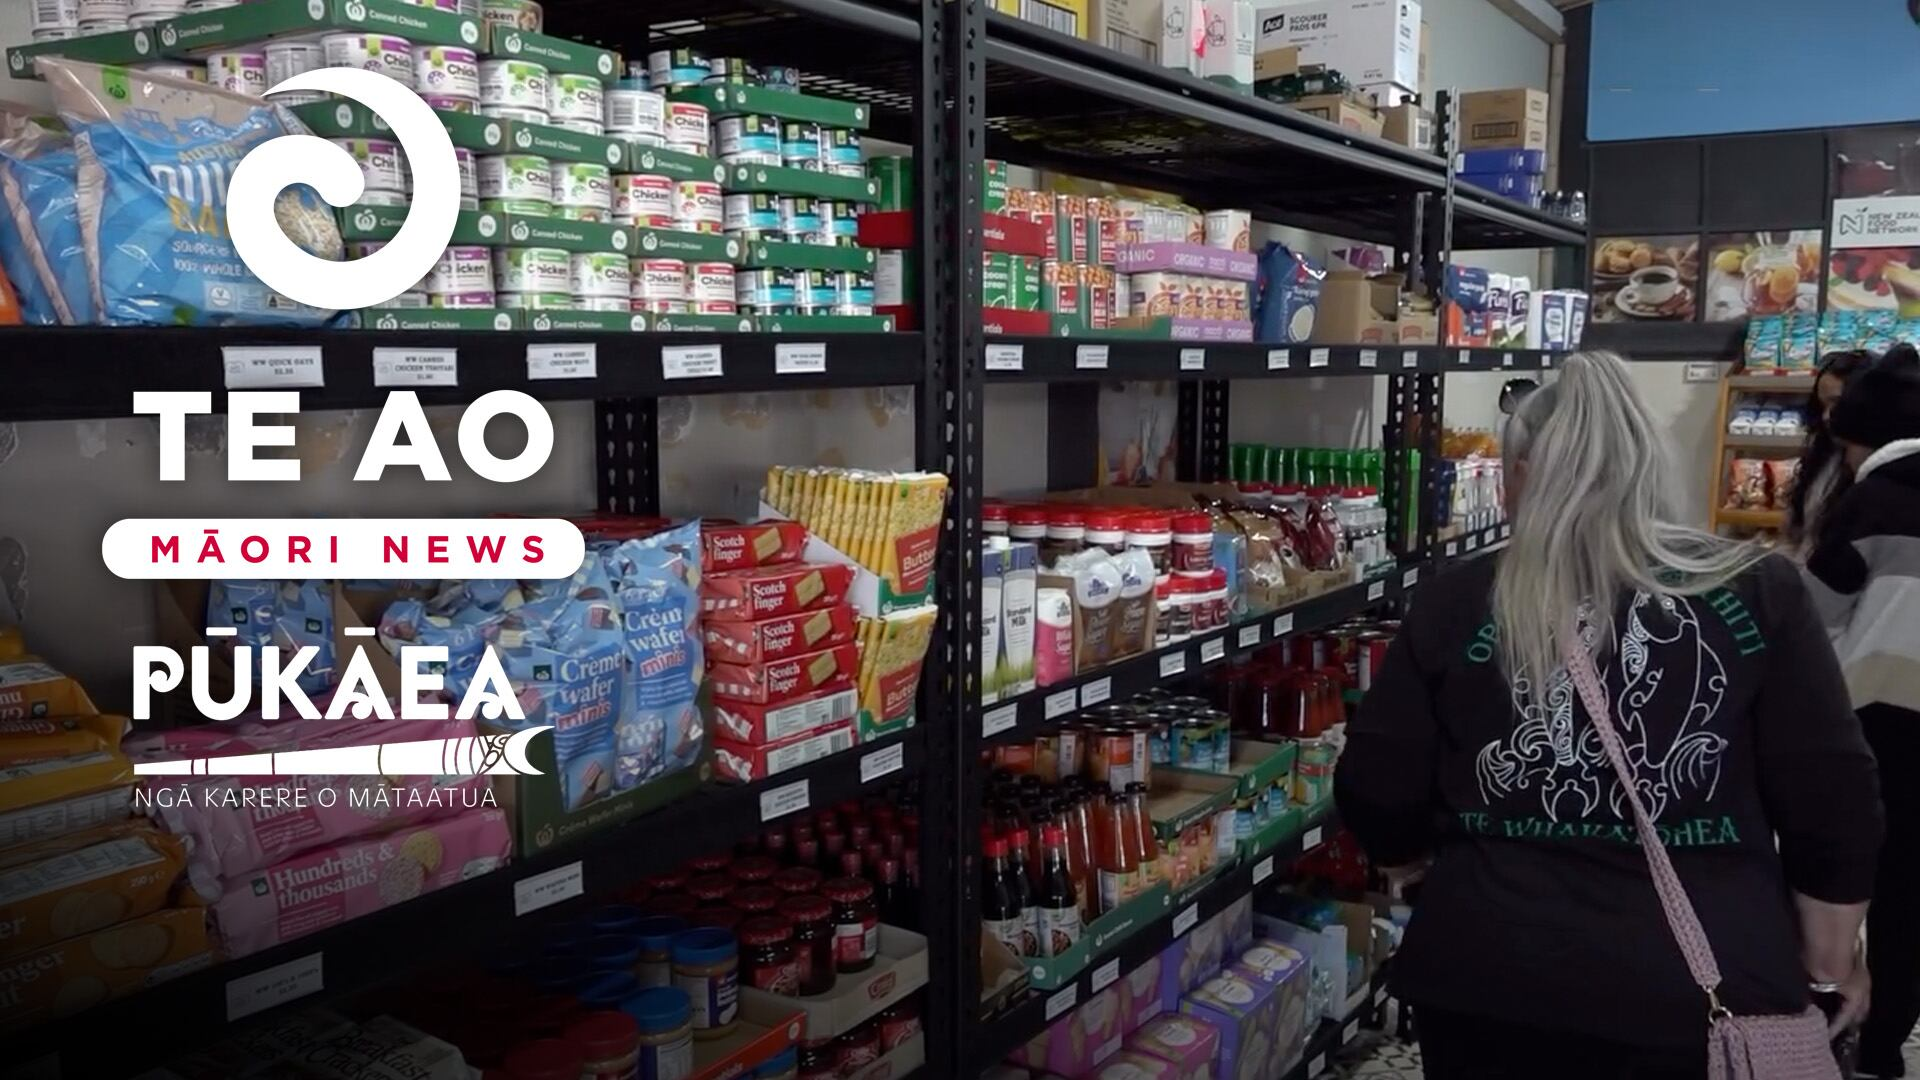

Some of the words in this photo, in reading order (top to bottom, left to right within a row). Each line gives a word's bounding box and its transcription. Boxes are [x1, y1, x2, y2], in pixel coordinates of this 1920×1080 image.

[368, 9, 398, 23] Canned
[398, 14, 428, 28] Chicken
[482, 10, 515, 22] icken
[1289, 14, 1328, 24] SCOURER
[1289, 22, 1310, 32] PADS
[1312, 22, 1328, 30] 6PK
[674, 116, 706, 128] Chicke
[526, 171, 550, 183] Chic
[380, 217, 404, 227] Can
[1896, 212, 1920, 220] ZEAL
[532, 229, 557, 239] Canned
[558, 232, 584, 242] Chicken
[1867, 226, 1919, 234] NETWORK
[1118, 249, 1155, 263] GANIC
[202, 262, 242, 277] WHOLE
[701, 276, 733, 286] Chicke
[401, 320, 429, 329] Canned
[429, 320, 461, 329] Chicken
[268, 358, 292, 367] QUICK
[293, 358, 314, 366] OATS
[713, 534, 745, 548] Scotch
[714, 548, 742, 563] finger
[903, 548, 936, 570] Butte
[752, 580, 786, 596] Scotch
[754, 596, 784, 612] finger
[626, 608, 683, 632] Crèm
[1011, 616, 1026, 628] Milk
[1708, 588, 1767, 656] HITI
[762, 621, 795, 637] Scotch
[764, 636, 792, 652] finger
[640, 651, 687, 678] minis
[769, 663, 800, 678] Scotch
[559, 677, 614, 705] wafer
[770, 676, 798, 694] finger
[887, 682, 916, 706] Butte
[555, 700, 612, 731] minis
[558, 818, 588, 837] Crème
[1459, 812, 1490, 832] TE
[1504, 816, 1742, 848] WHAKAOHEA
[273, 847, 374, 892] Hundreds
[377, 842, 396, 862] &
[278, 868, 378, 910] thousands
[0, 949, 64, 984] nger
